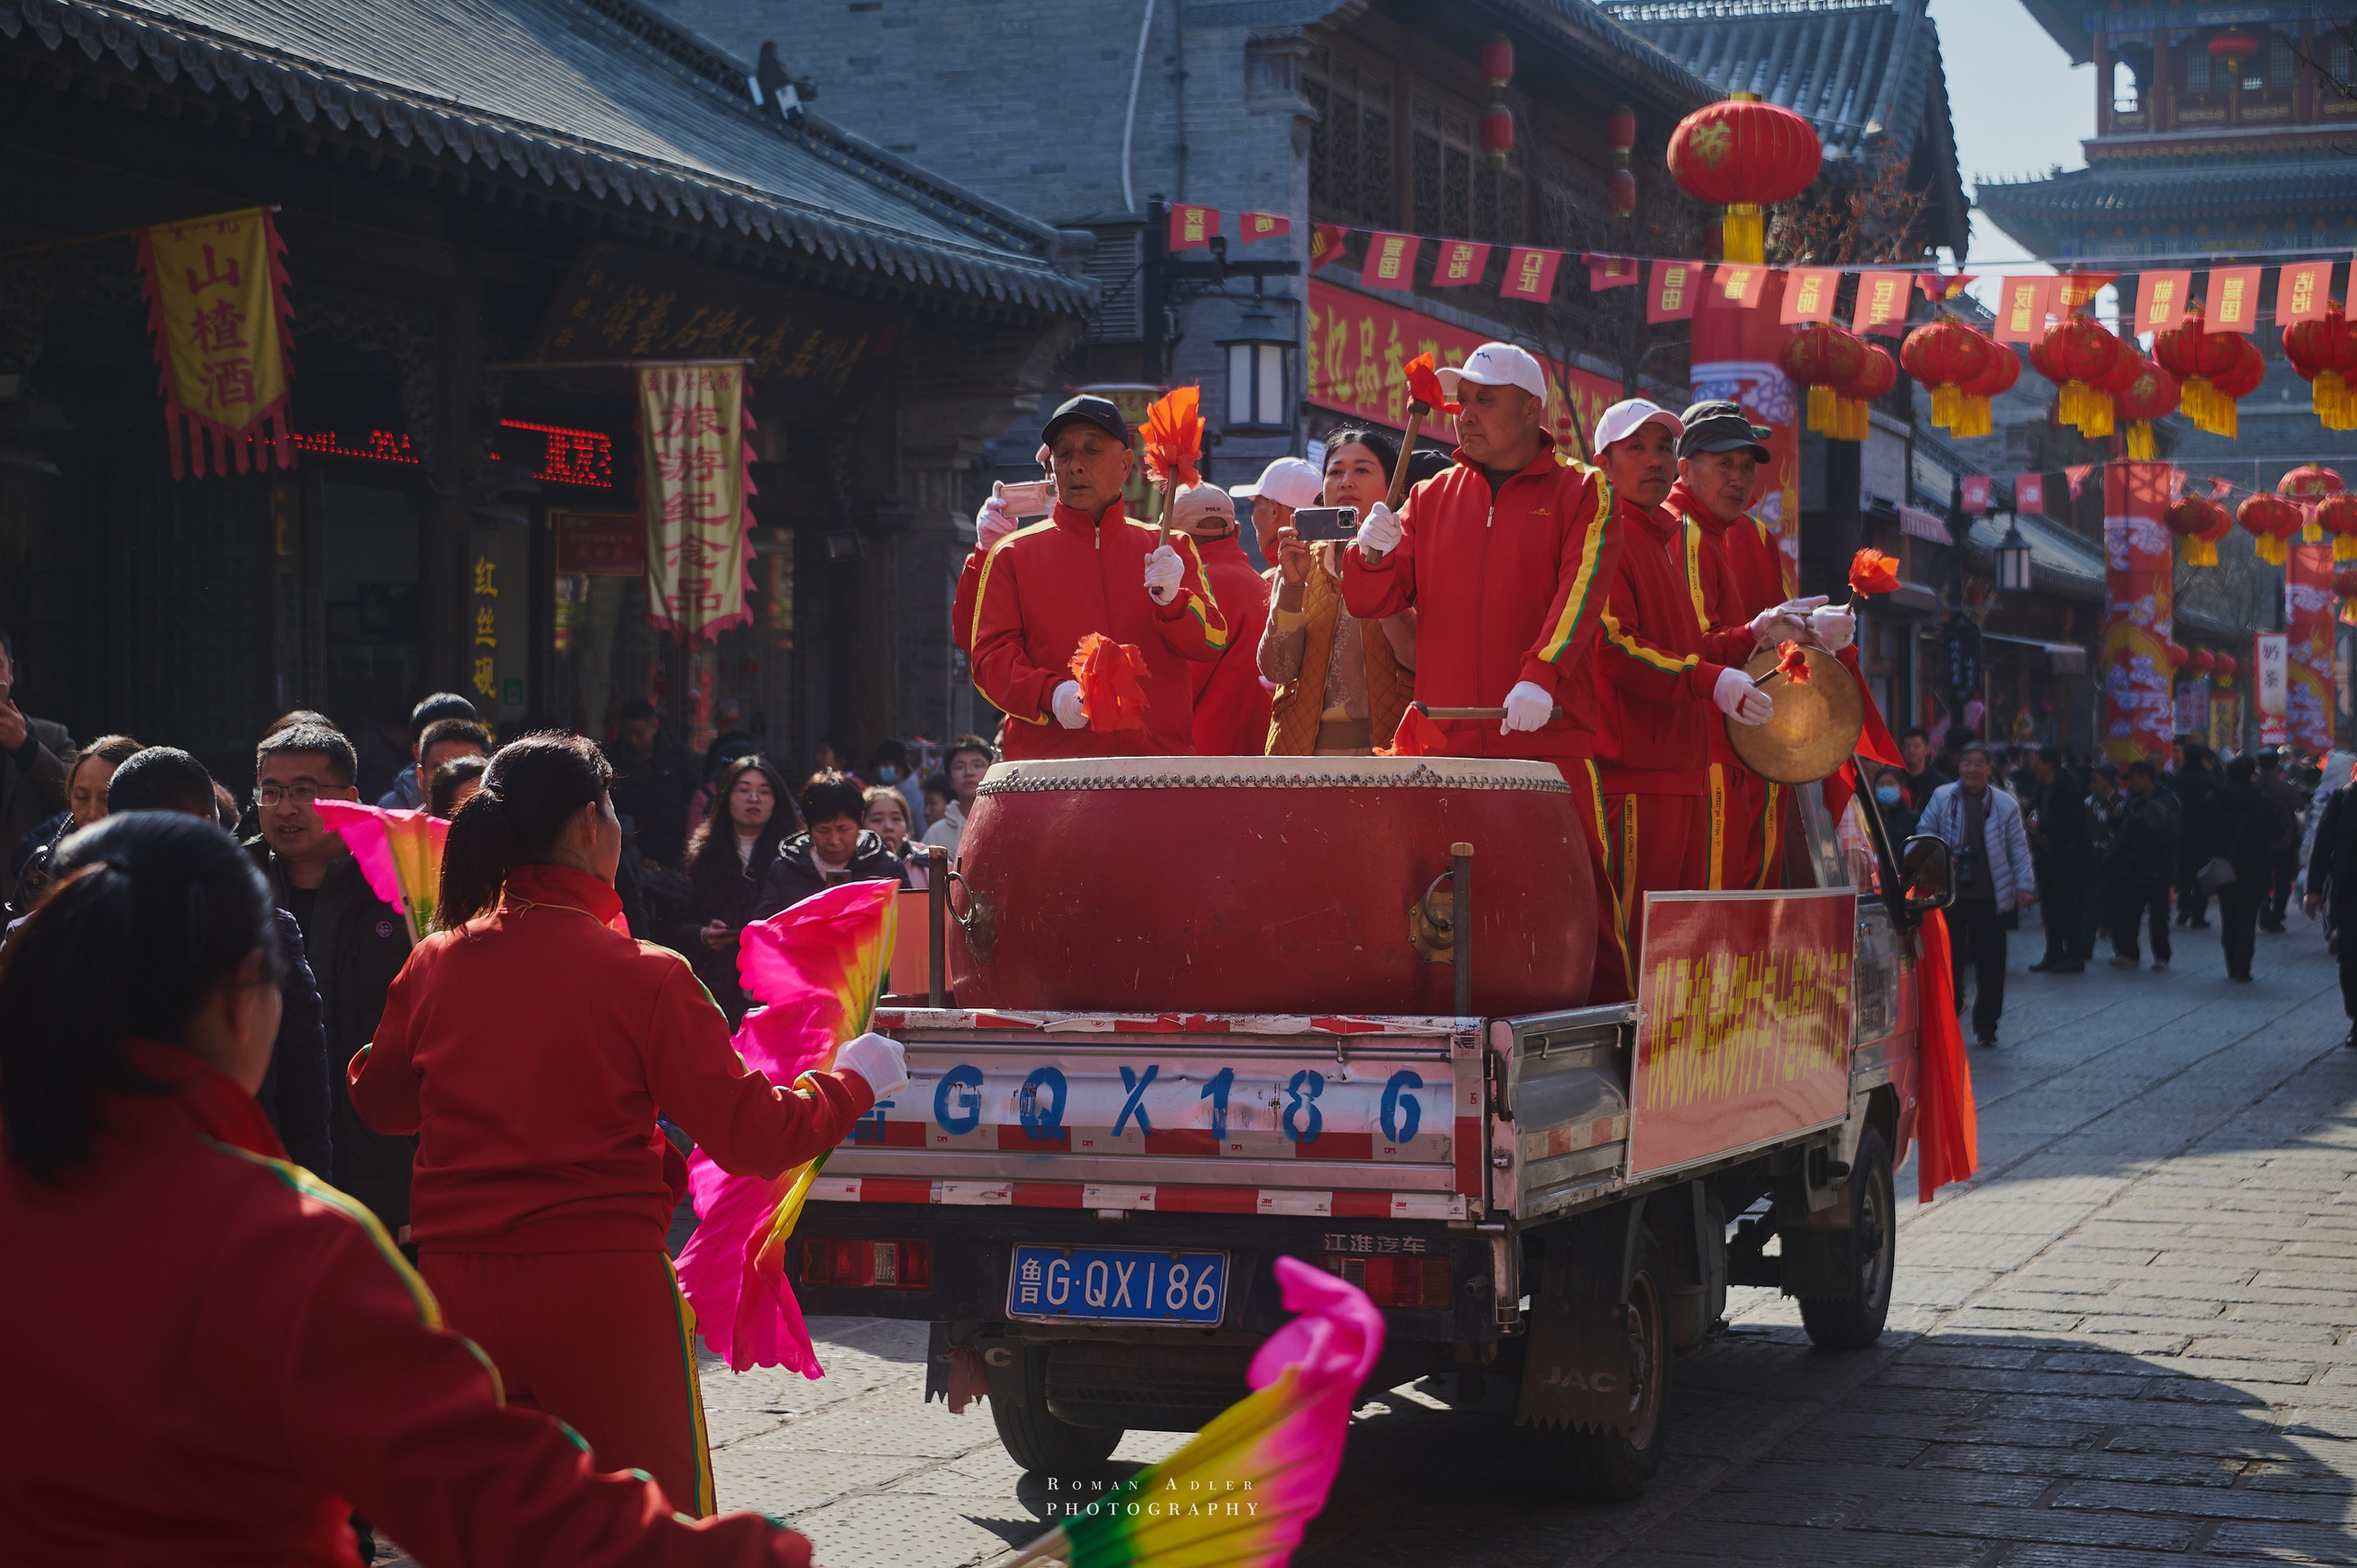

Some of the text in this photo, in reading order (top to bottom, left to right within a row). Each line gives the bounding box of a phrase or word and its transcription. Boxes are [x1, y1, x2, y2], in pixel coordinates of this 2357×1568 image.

[186, 244, 256, 411] 山楂酒
[652, 401, 731, 614] 旅游纪念品
[473, 555, 499, 744] 红丝砚
[2263, 644, 2280, 691] 奶茶
[844, 1063, 1423, 1145] GQX186
[1324, 1233, 1426, 1254] 江淮汽车
[1534, 1365, 1618, 1393] JAC
